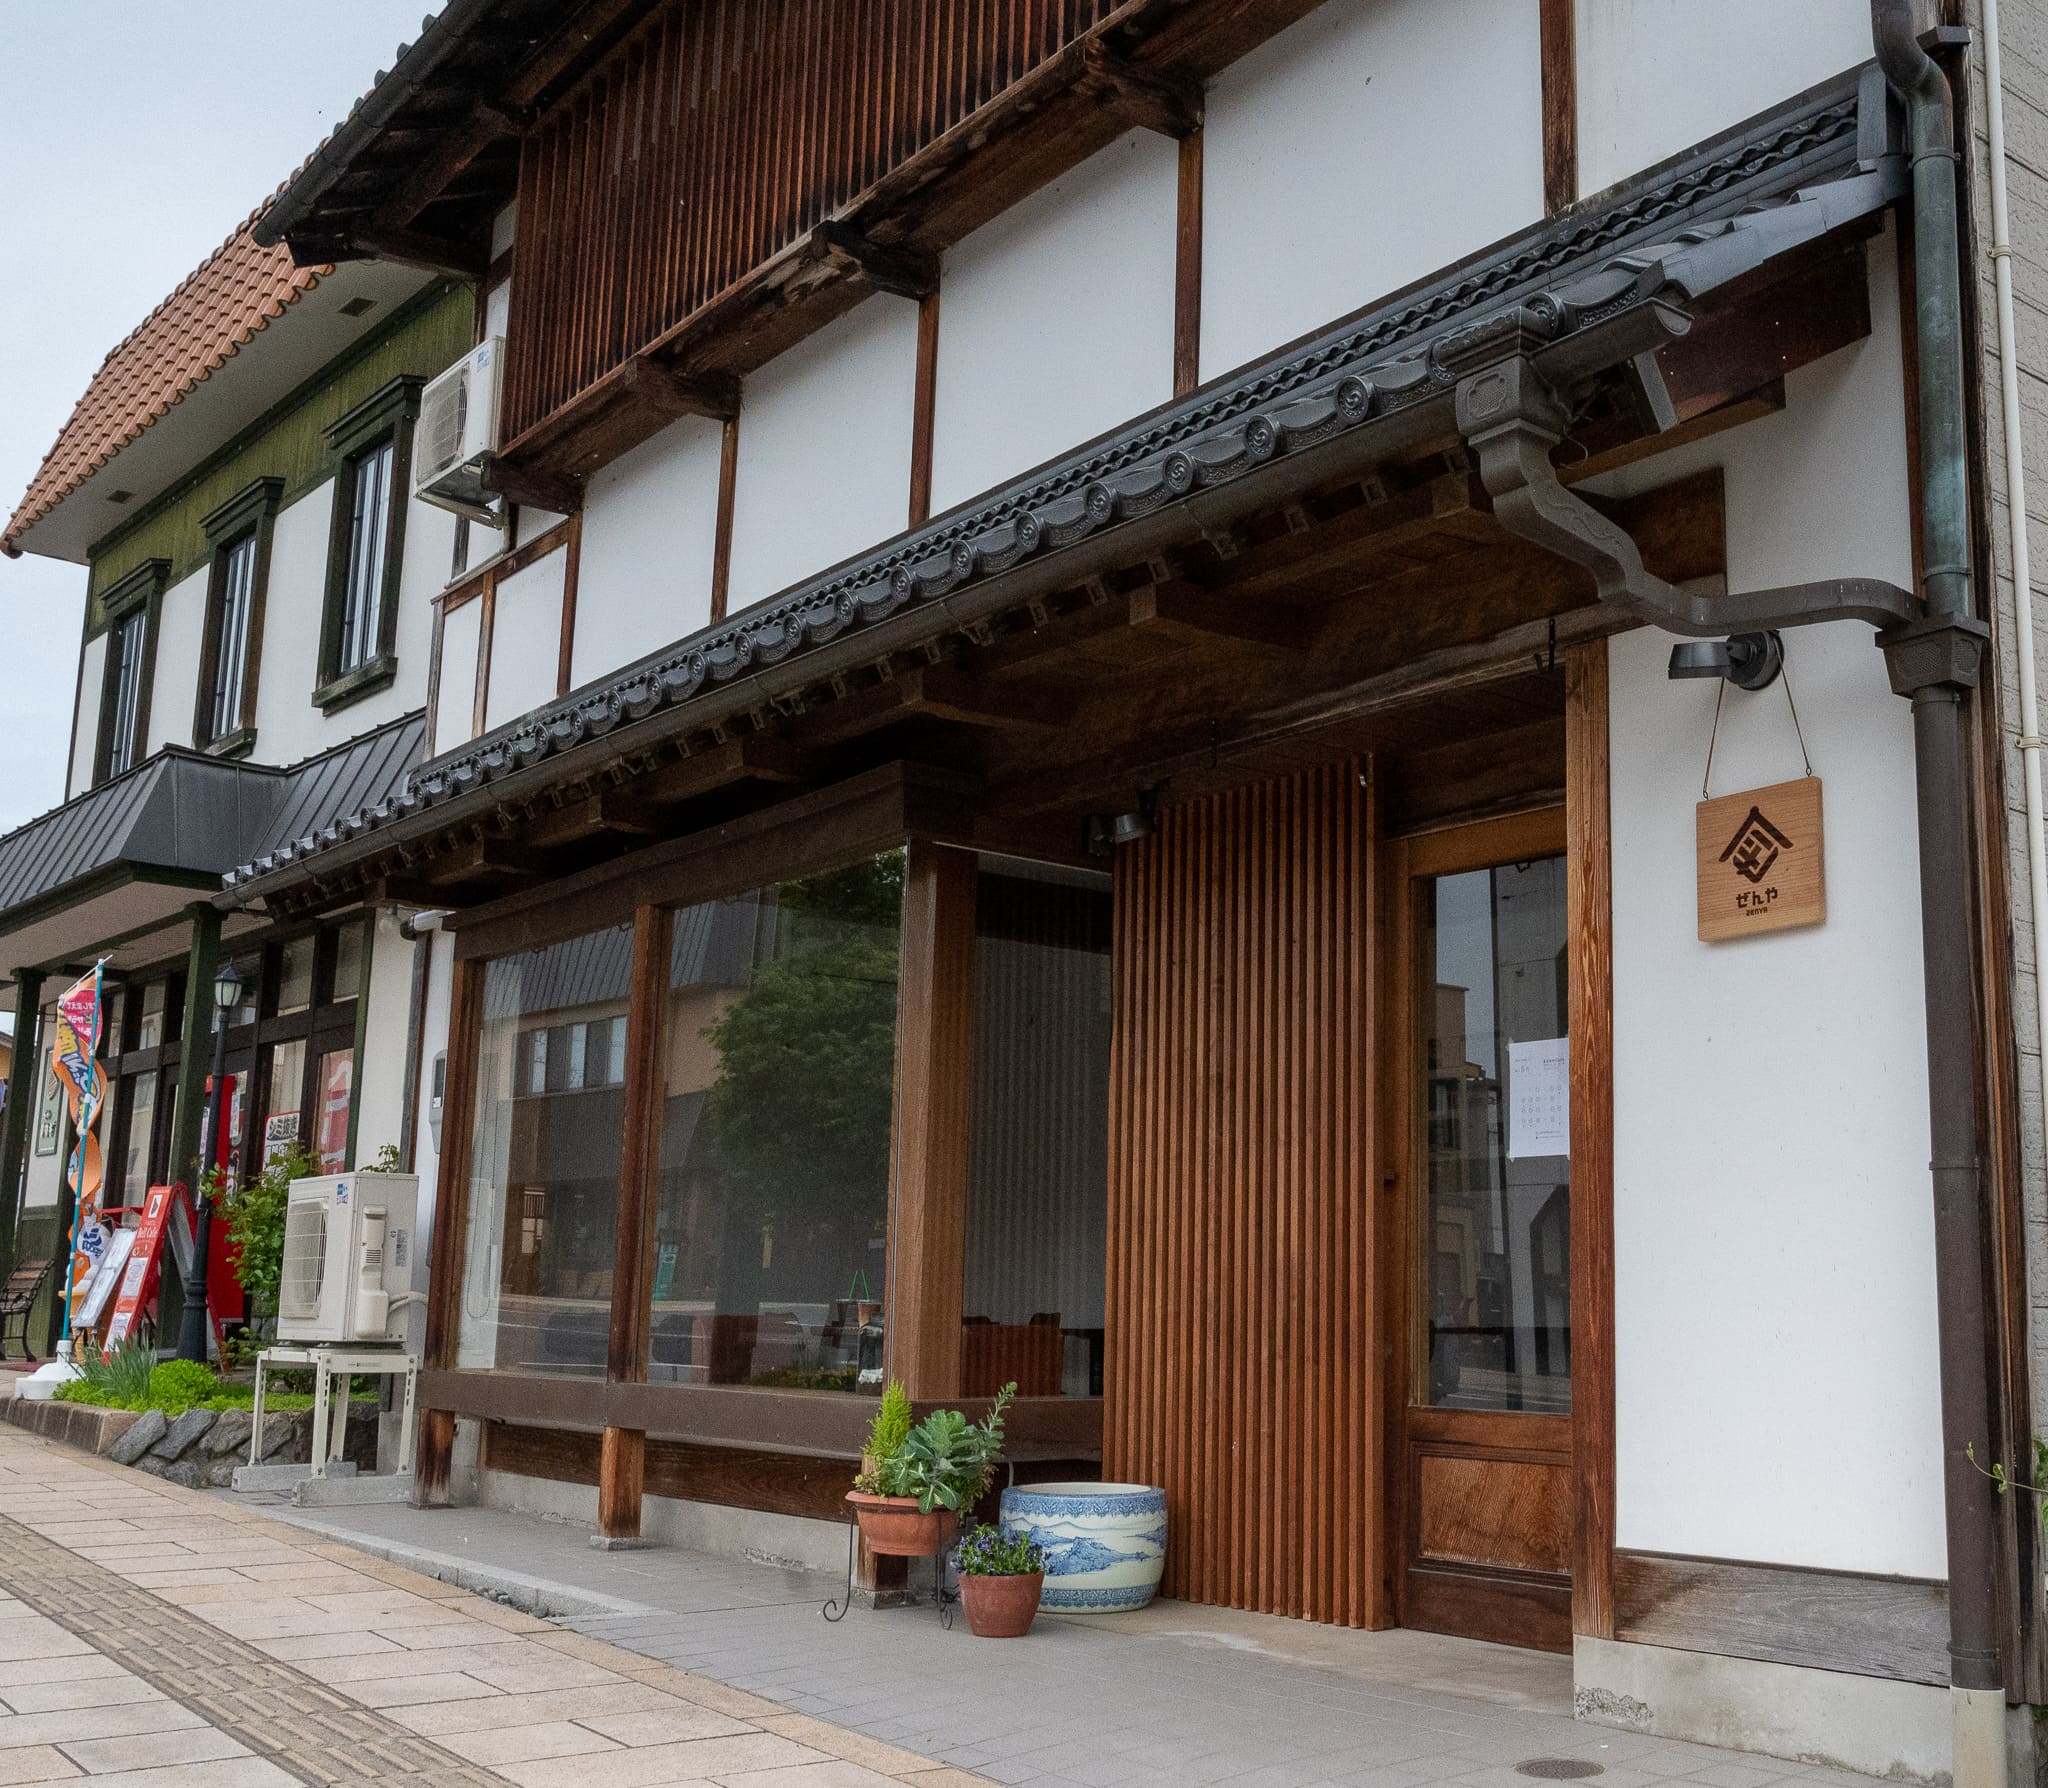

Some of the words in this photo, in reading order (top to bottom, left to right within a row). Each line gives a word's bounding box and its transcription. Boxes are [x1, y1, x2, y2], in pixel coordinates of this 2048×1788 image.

[1735, 887, 1778, 908] ぜんや
[1746, 907, 1767, 916] ZENYA
